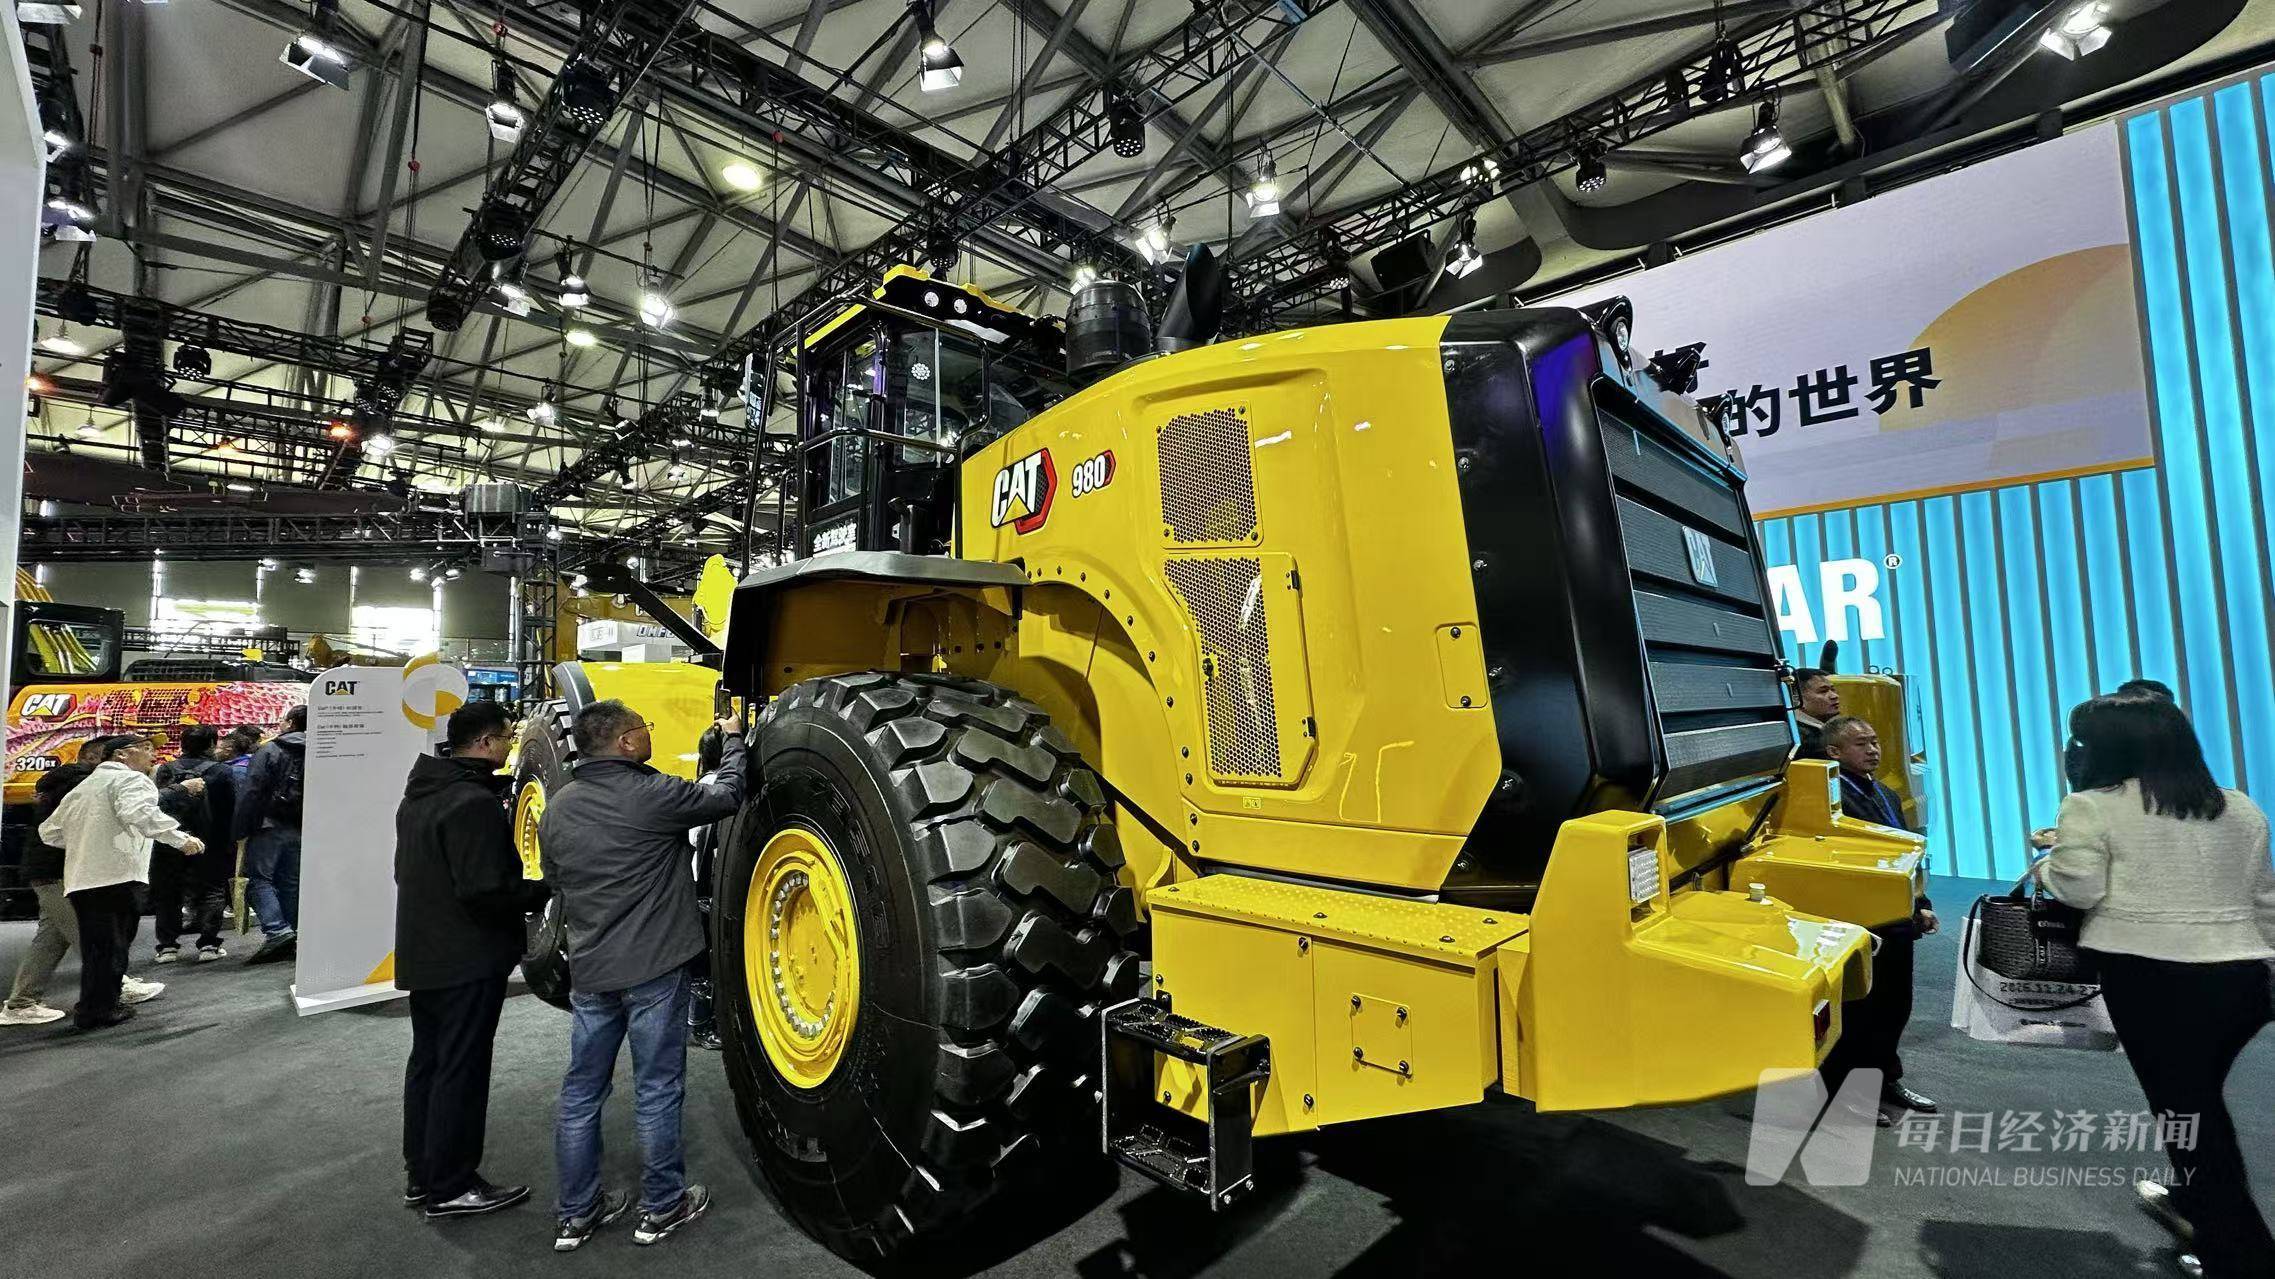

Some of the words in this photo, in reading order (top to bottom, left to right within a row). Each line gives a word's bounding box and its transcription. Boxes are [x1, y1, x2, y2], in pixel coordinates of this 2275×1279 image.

[991, 451, 1043, 528] CAT
[1072, 454, 1106, 498] 980
[21, 694, 71, 716] CAT
[325, 681, 358, 696] CAT
